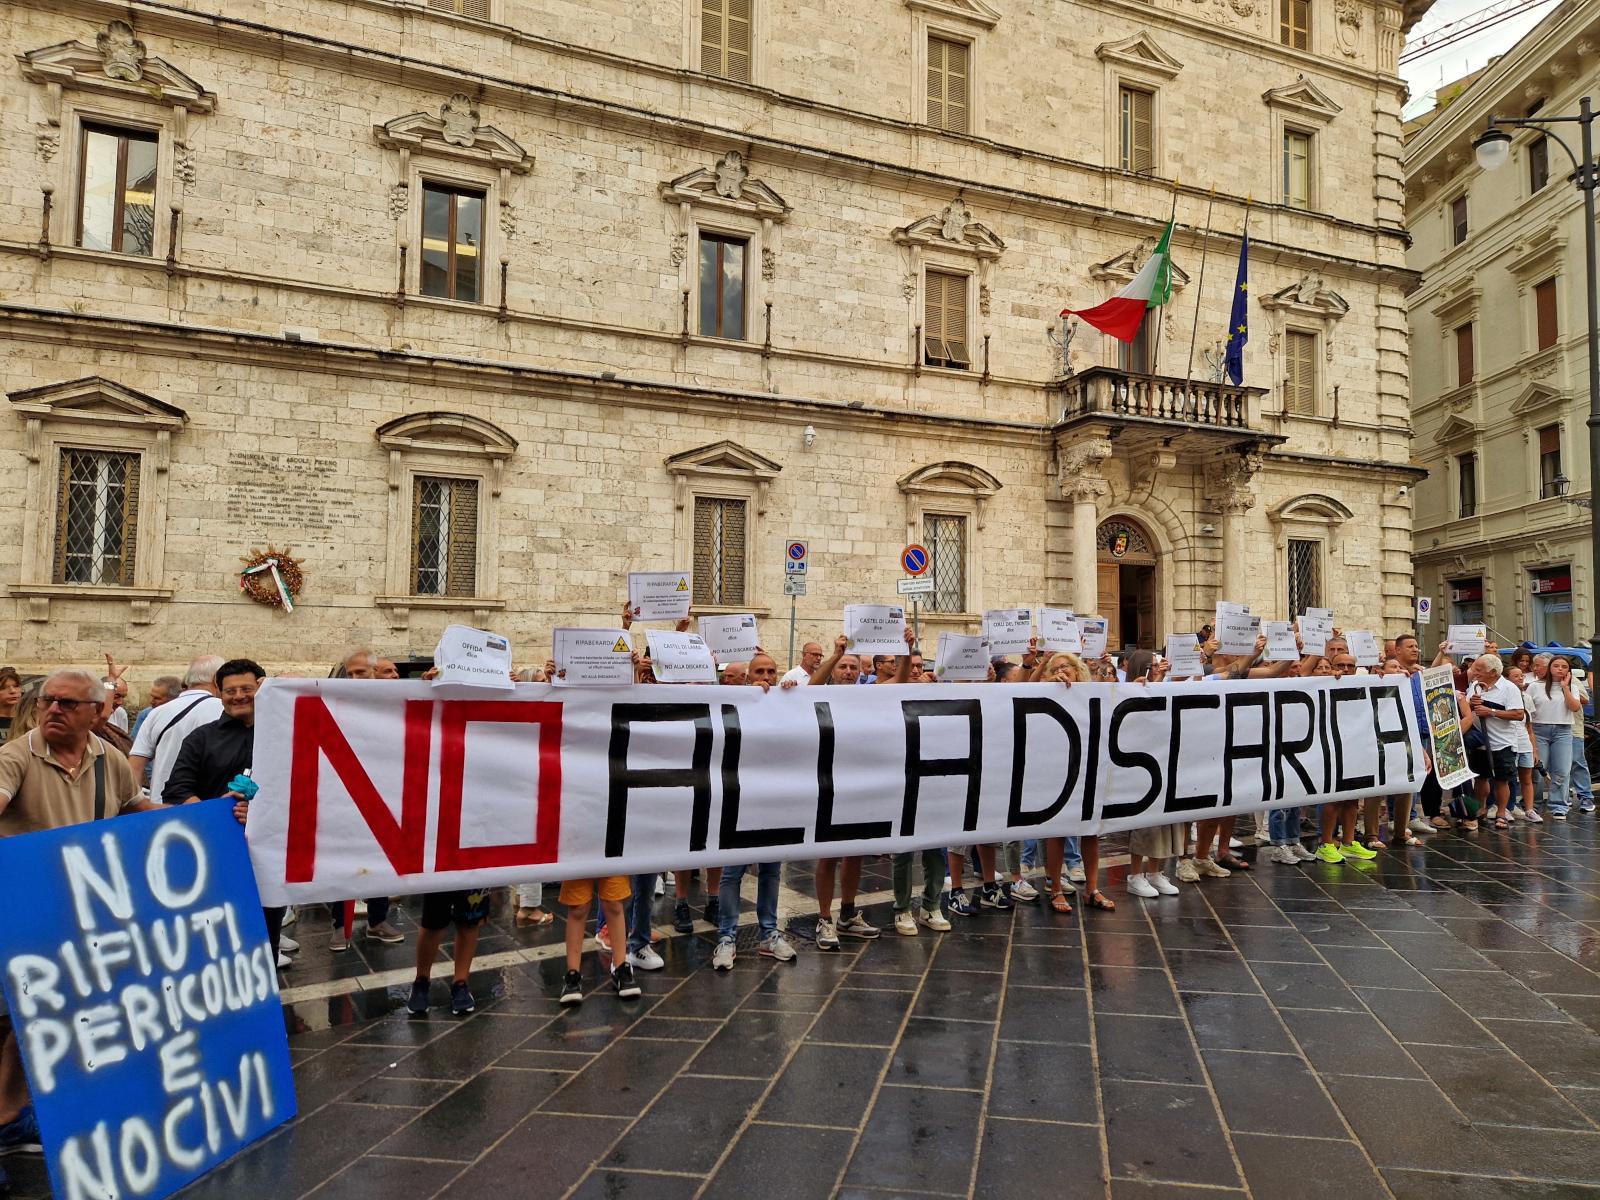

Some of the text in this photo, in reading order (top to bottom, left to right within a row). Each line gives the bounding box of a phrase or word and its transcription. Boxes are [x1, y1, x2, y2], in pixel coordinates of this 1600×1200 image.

[446, 663, 505, 676] NO ALLA DISCARICA
[461, 642, 483, 652] OFFIDA
[286, 685, 1416, 884] NO ALLA DISCARICA
[62, 819, 208, 931] NO
[7, 901, 242, 1018] RIFIUTI
[25, 941, 280, 1093] PERICOLOSI
[159, 1030, 203, 1094] E
[59, 1051, 274, 1200] NOCIVI
